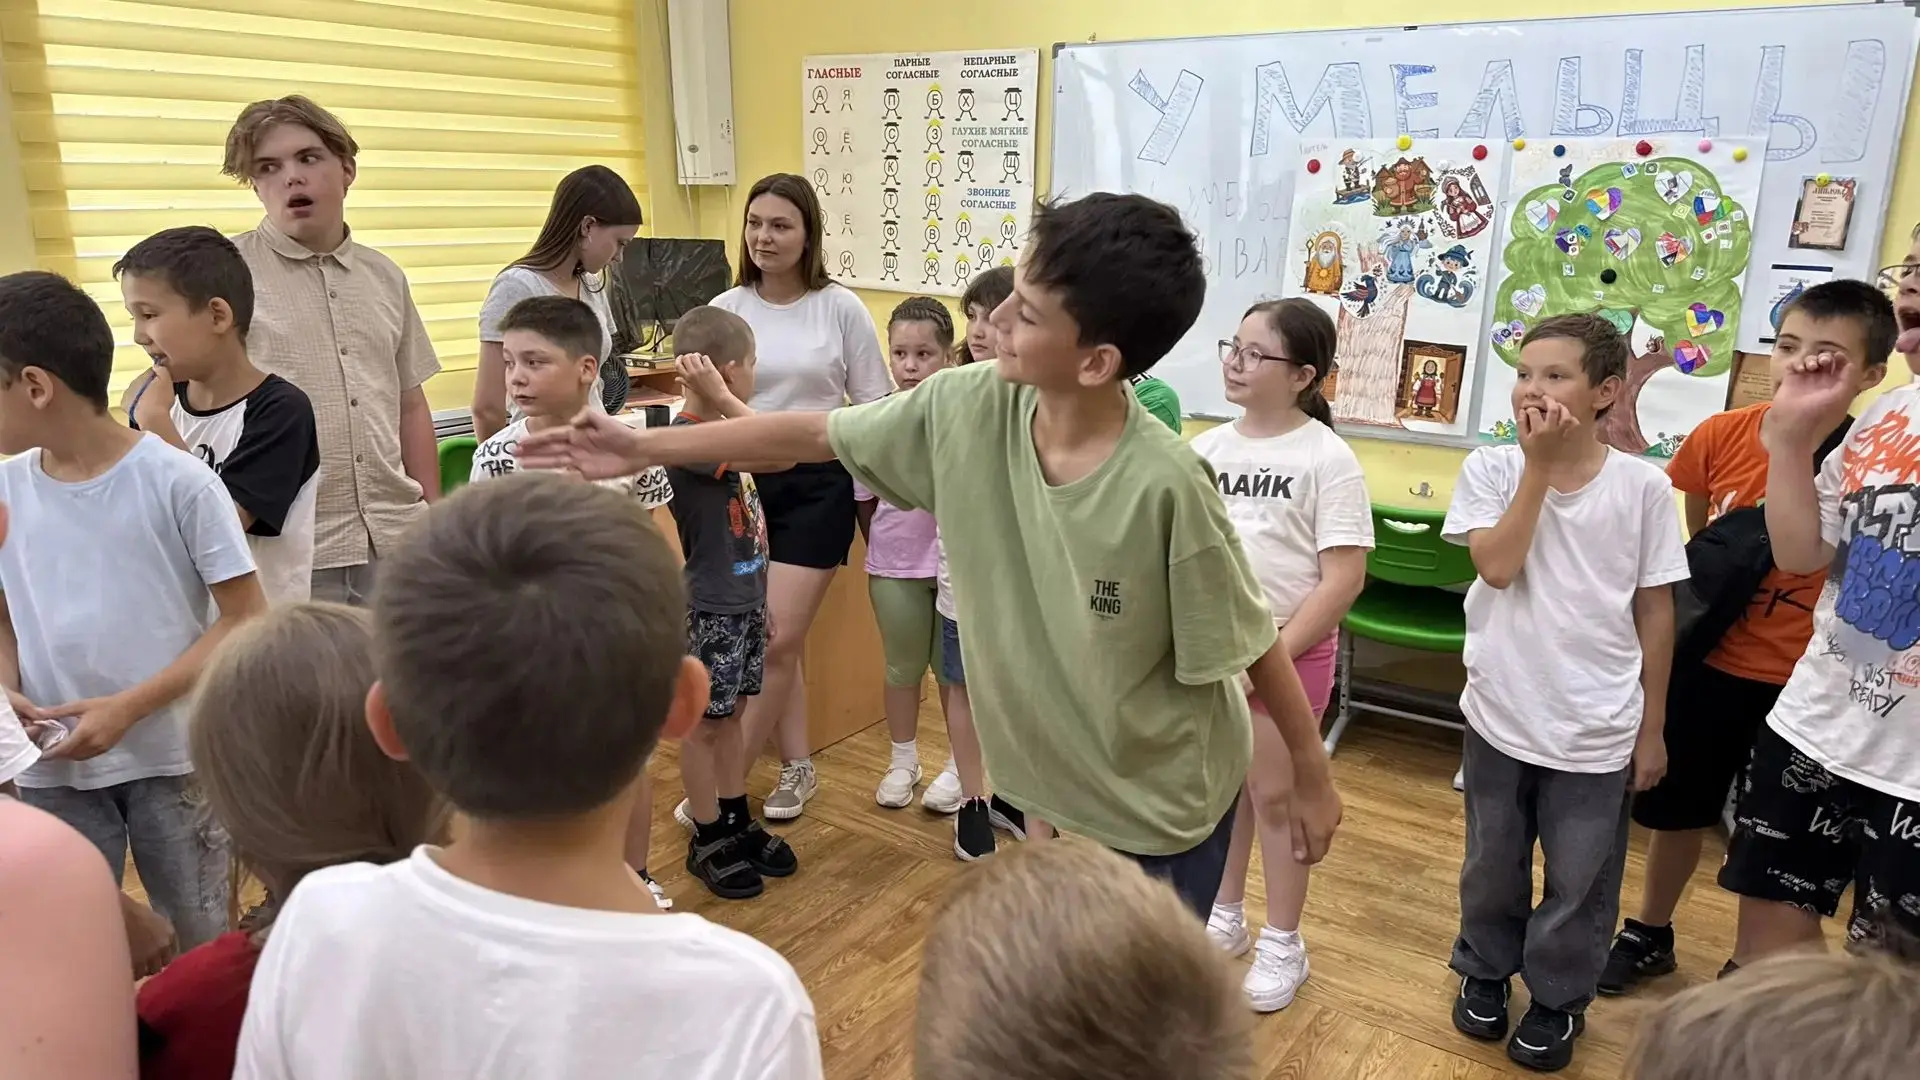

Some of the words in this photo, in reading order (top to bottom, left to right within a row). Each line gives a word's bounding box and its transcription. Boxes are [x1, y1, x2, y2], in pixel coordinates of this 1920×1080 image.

[894, 58, 931, 67] ПАРНЫЕ
[964, 56, 1016, 66] НЕПАРНЫЕ
[808, 68, 861, 79] ГЛАСНЫЕ
[886, 70, 939, 79] СОГЛАСНЫЕ
[961, 69, 1018, 78] СОГЛАСНЫЕ
[952, 127, 987, 136] ГЛУХИЕ
[990, 127, 1028, 136] МЯГКИЕ
[962, 139, 1018, 148] СОГЛАСНЫЕ
[967, 188, 1010, 197] ЗВОНКИЕ
[961, 200, 1016, 209] СОГЛАСНЫЕ
[637, 482, 673, 503] THE
[1094, 579, 1121, 597] THE
[1090, 595, 1121, 615] KING
[1848, 679, 1906, 718] READY
